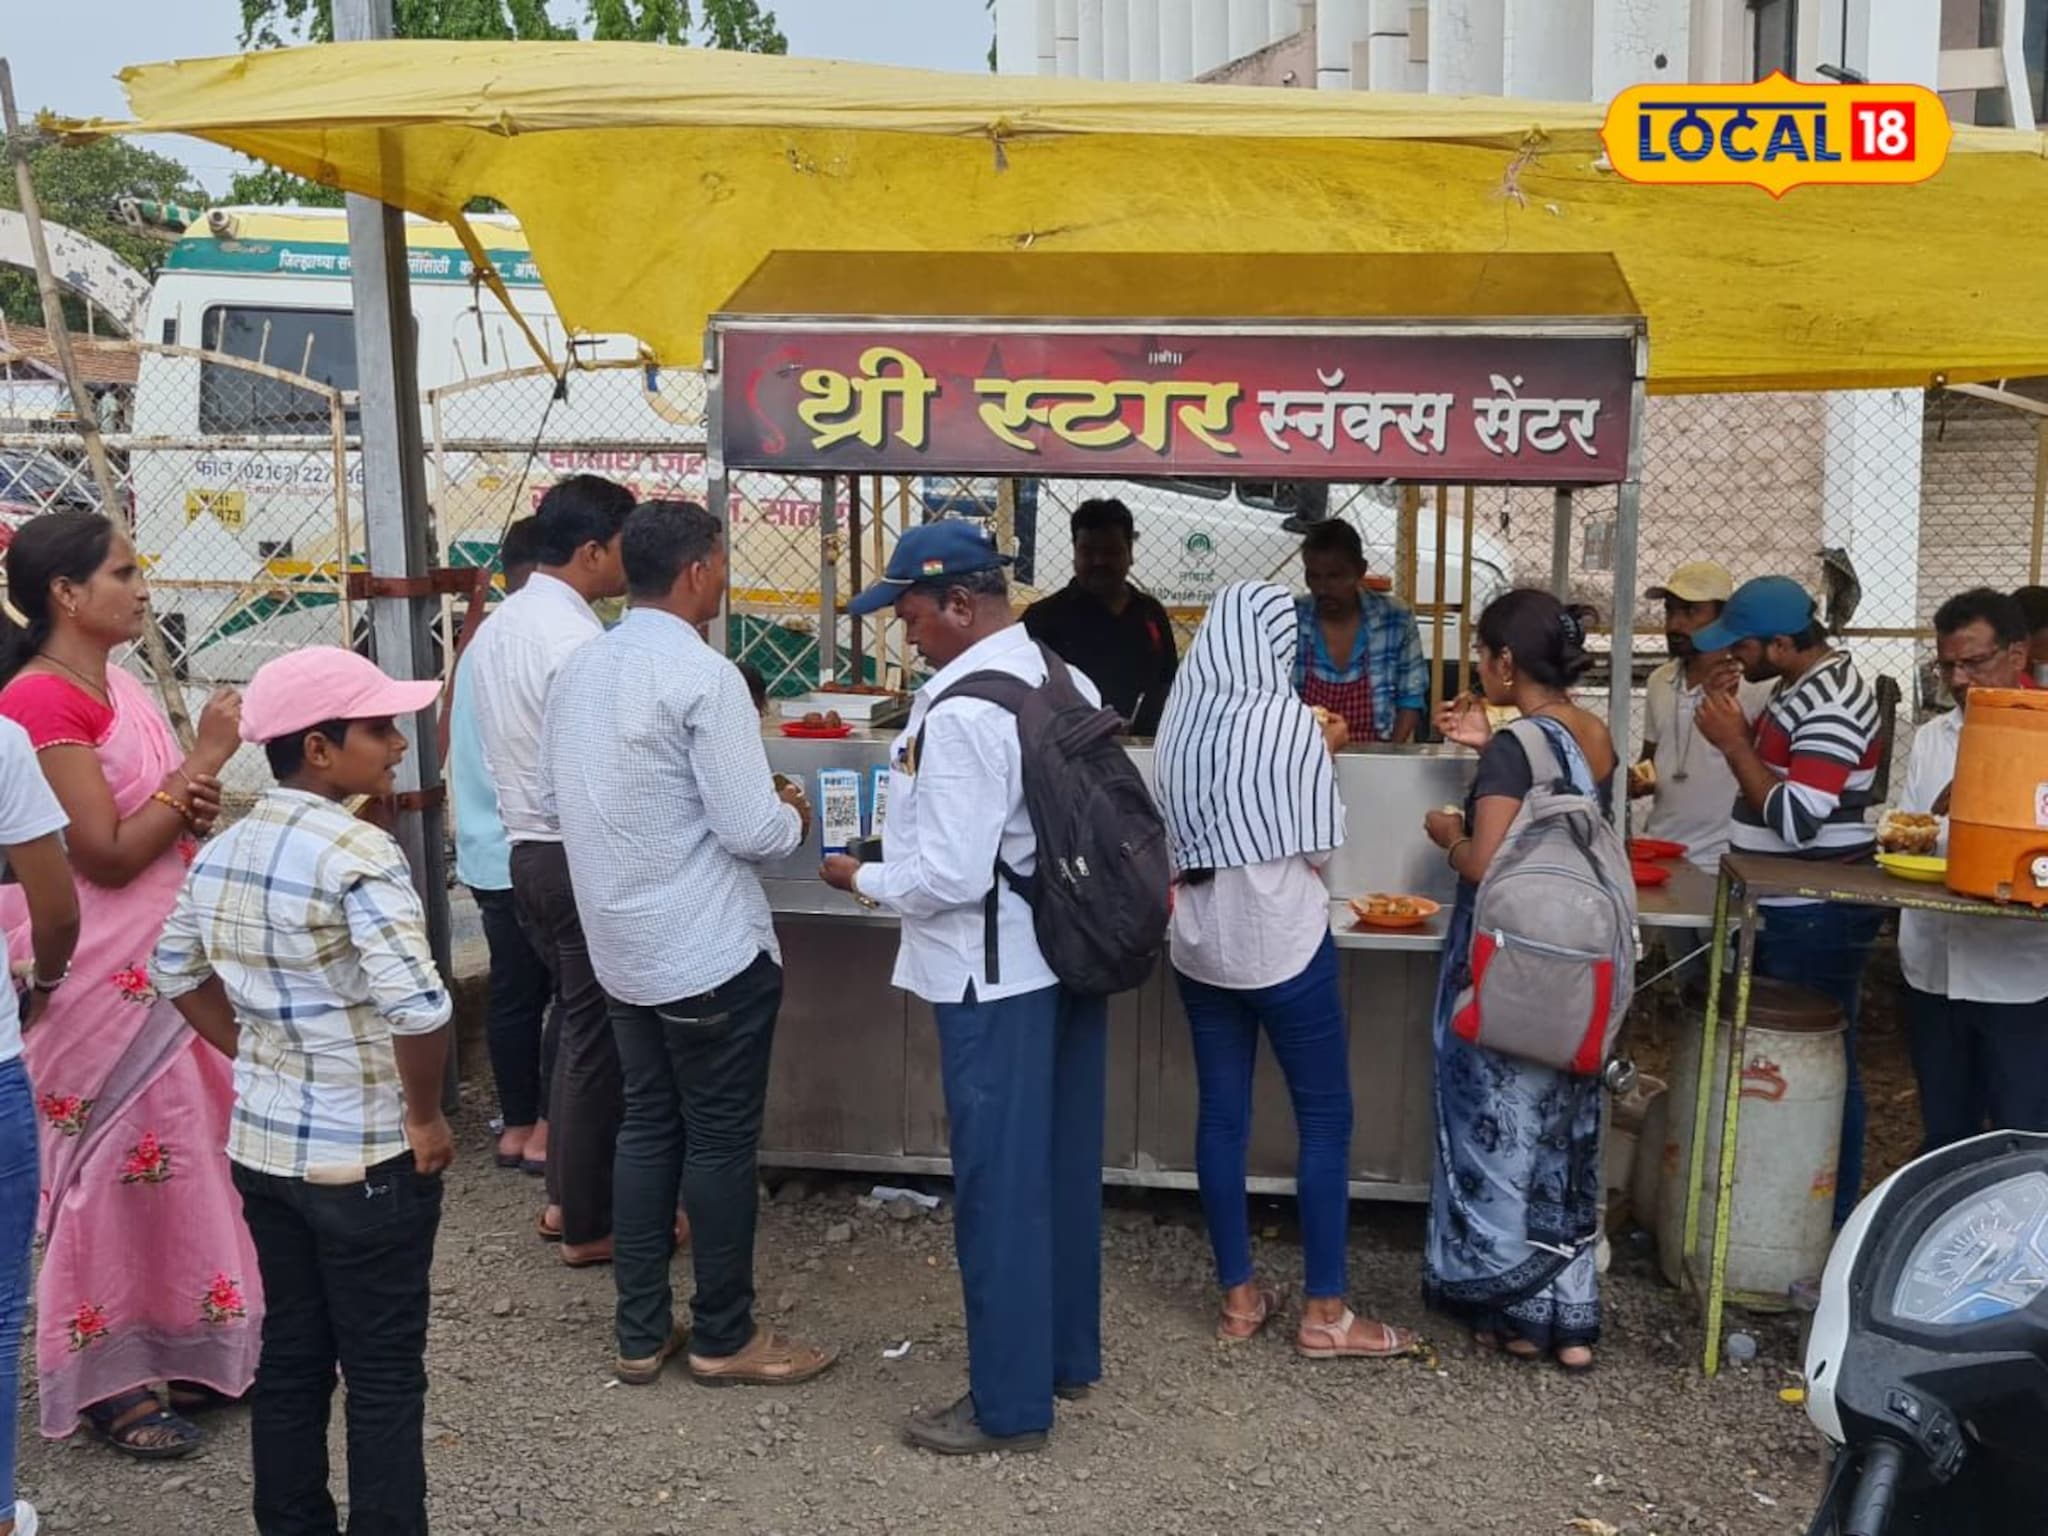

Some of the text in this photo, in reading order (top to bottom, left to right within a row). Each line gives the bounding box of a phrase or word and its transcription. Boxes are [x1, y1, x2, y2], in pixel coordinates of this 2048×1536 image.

[797, 346, 1601, 455] थ्री स्टार स्नॅक्स सेंटर
